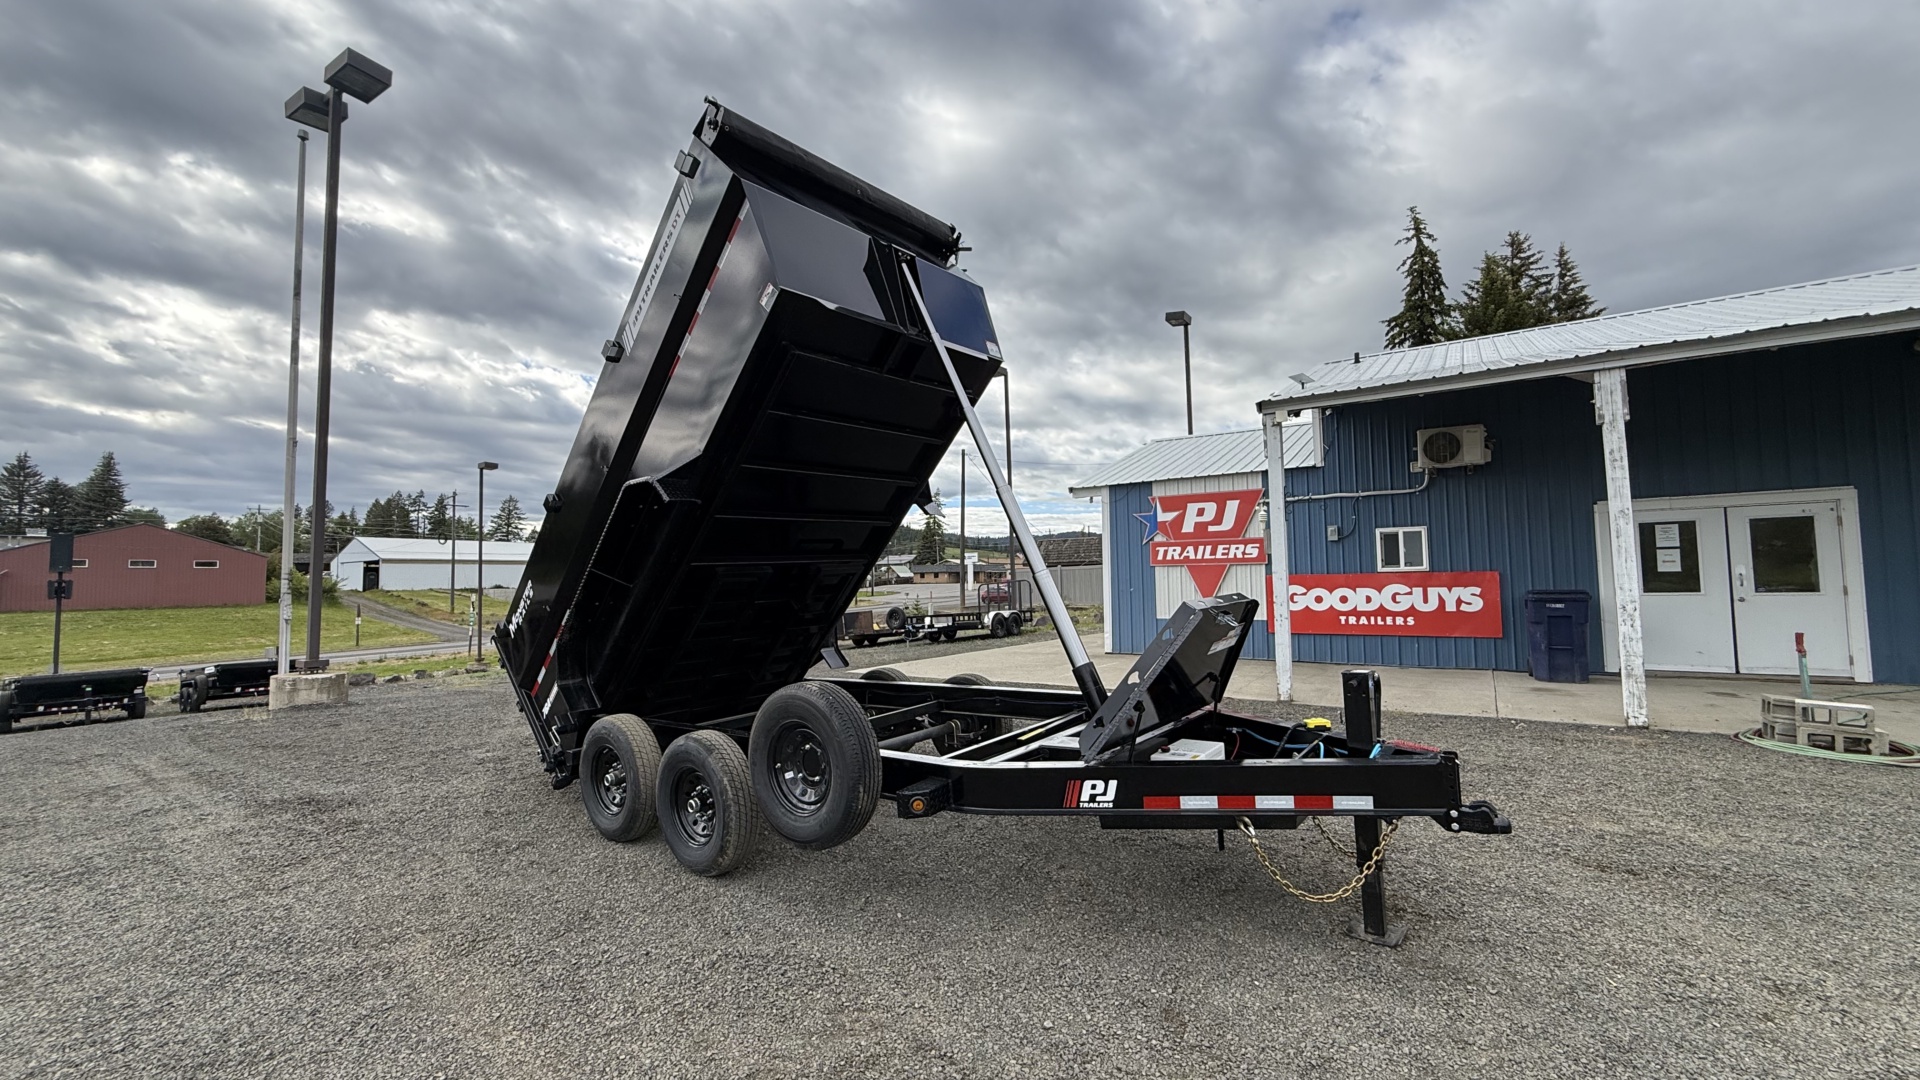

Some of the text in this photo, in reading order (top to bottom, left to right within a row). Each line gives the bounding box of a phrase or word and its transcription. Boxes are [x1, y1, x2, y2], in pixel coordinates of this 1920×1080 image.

[671, 209, 682, 230] DT
[1181, 500, 1241, 534] PJ
[1155, 543, 1260, 561] TRAILERS
[1339, 615, 1416, 626] TRAILERS
[1079, 779, 1118, 801] PJ
